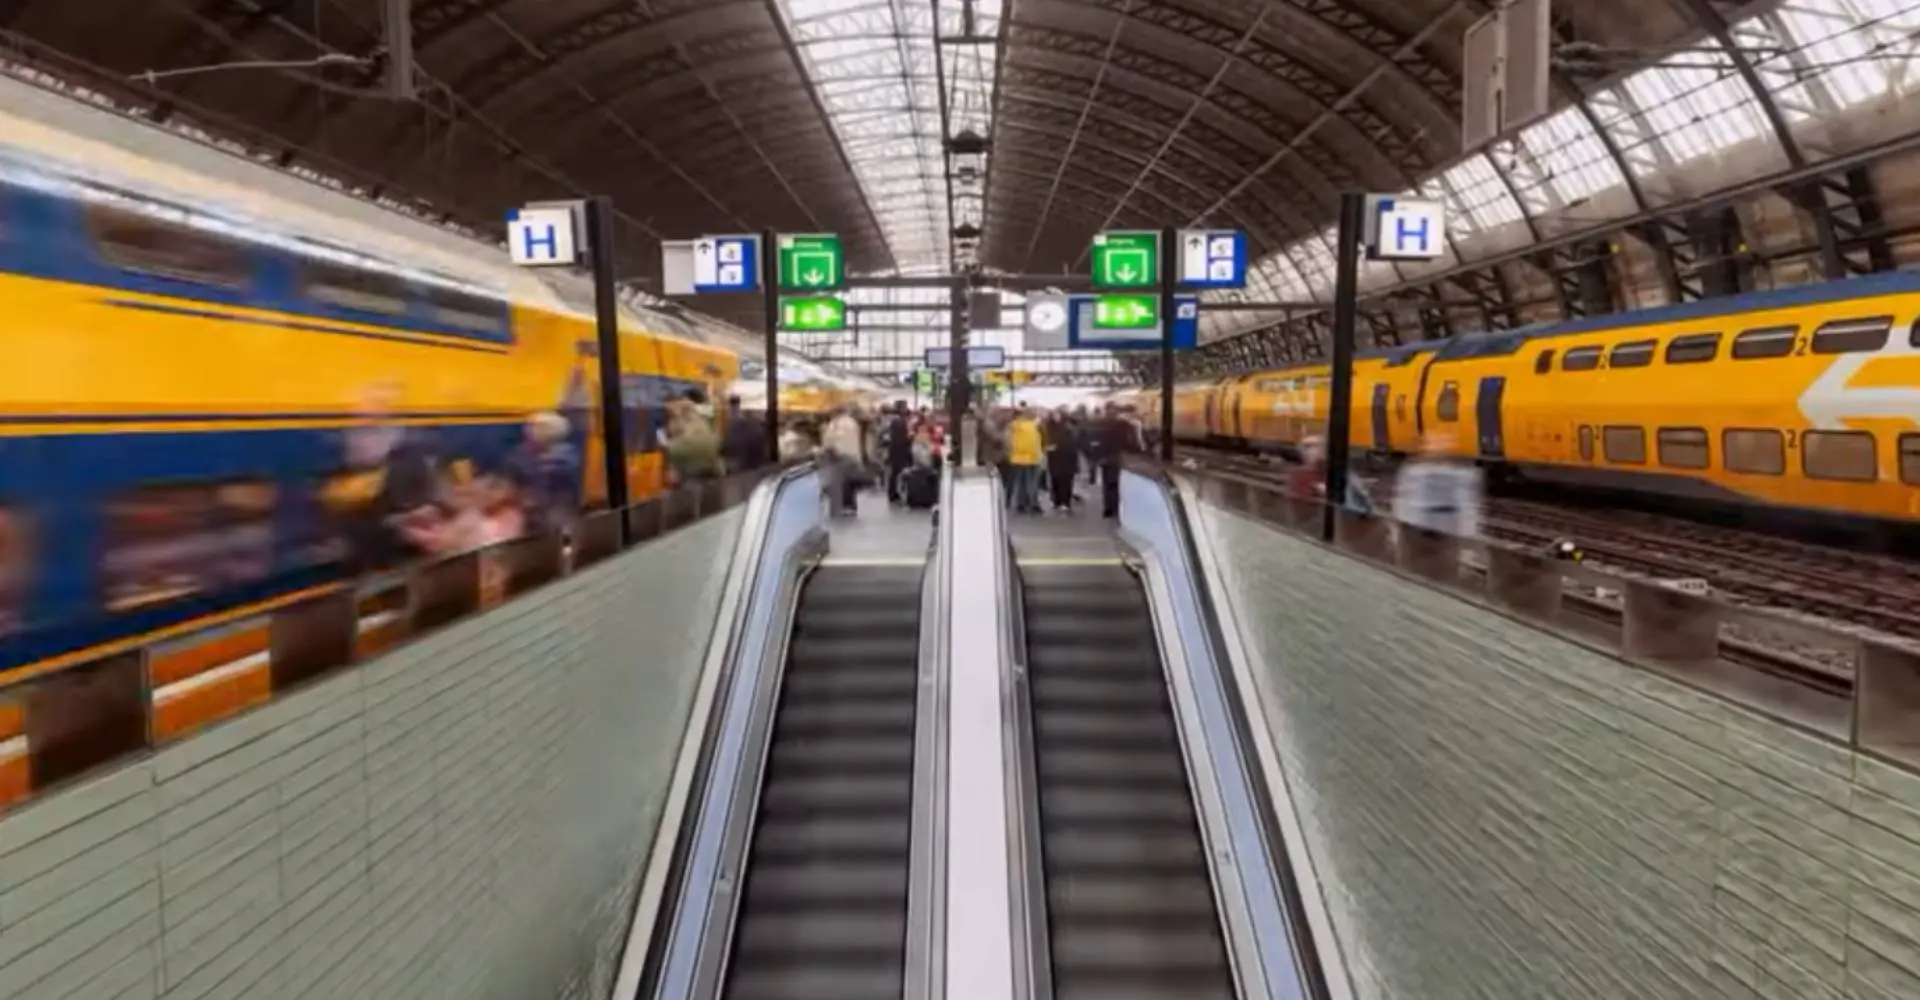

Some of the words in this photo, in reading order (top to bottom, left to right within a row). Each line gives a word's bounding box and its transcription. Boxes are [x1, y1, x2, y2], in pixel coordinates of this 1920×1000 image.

[524, 224, 557, 259] H
[1397, 217, 1428, 251] H
[1796, 337, 1808, 357] 2
[1786, 428, 1798, 449] 2
